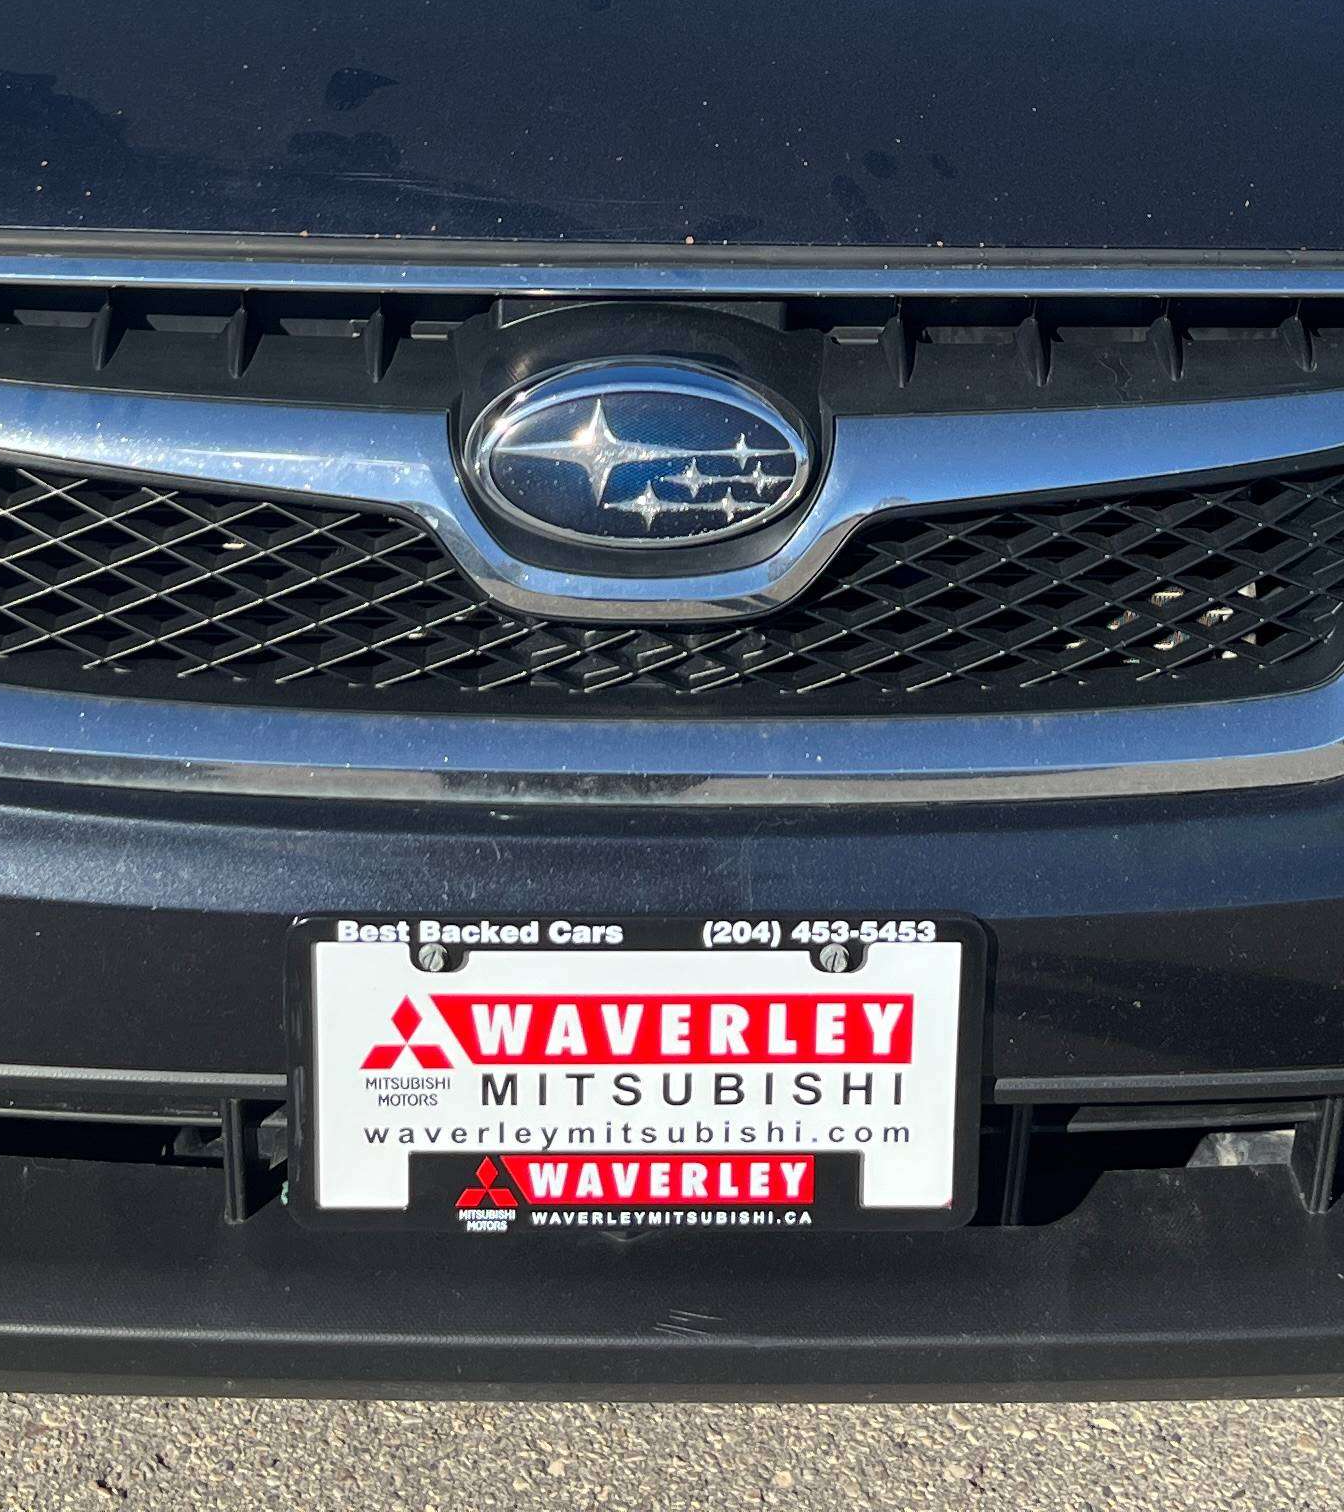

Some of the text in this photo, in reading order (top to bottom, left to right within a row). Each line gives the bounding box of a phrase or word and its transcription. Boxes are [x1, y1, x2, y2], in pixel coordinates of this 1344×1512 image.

[337, 920, 936, 948] Best Backed Cars (204) 453-5453
[471, 1003, 904, 1056] WAVERLEY
[365, 1076, 451, 1090] MITSUBISHI
[481, 1072, 902, 1106] MITSUBISHI
[378, 1093, 438, 1107] MOTORS
[364, 1121, 910, 1152] waverleymitsubishi.com
[528, 1162, 807, 1198] WAVERLEY
[458, 1208, 516, 1221] MITSUBISHI
[532, 1210, 813, 1226] WAVERLEYMITSUBISHI.CA
[466, 1220, 508, 1232] MOTORS
